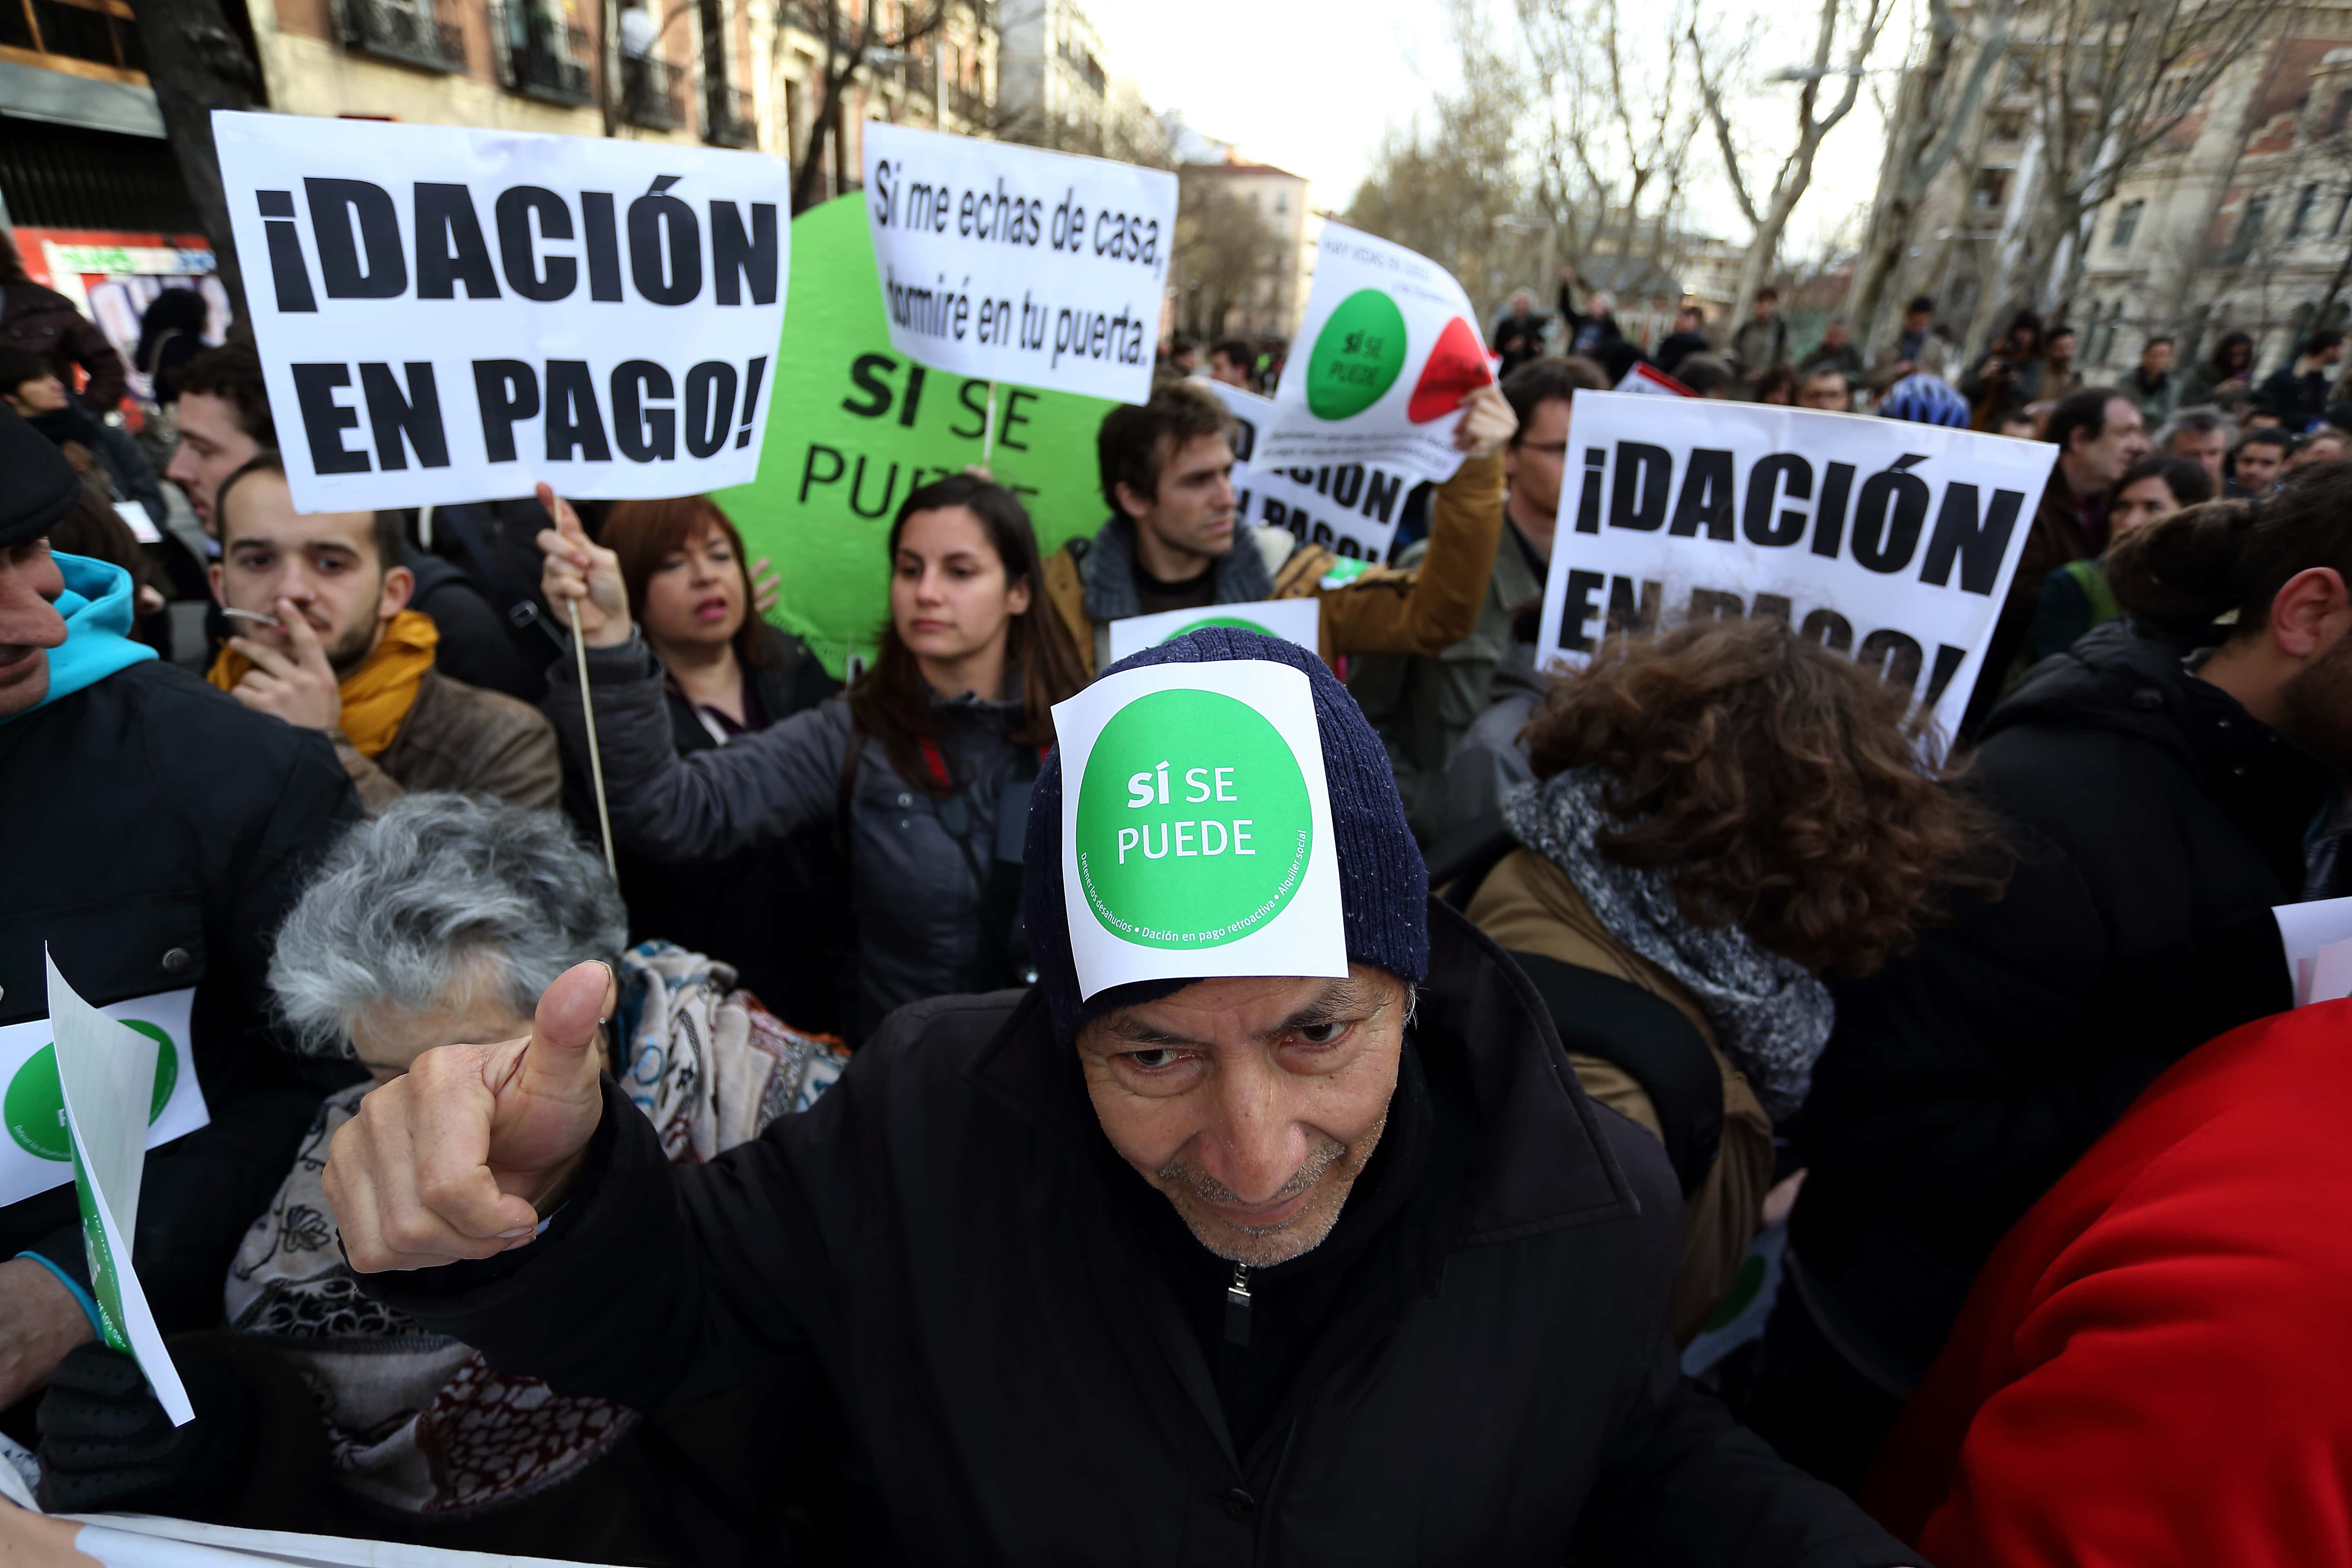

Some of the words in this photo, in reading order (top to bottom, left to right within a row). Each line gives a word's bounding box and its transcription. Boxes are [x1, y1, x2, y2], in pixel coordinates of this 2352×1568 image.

[255, 175, 777, 312] ¡DACIÓN
[906, 182, 949, 234] me
[959, 176, 1043, 246] echas
[1052, 186, 1084, 252] de
[1094, 209, 1164, 281] casa,
[978, 298, 1011, 346] en
[1021, 287, 1047, 350] tu
[1052, 300, 1147, 369] puerta.
[290, 362, 450, 475] EN
[472, 355, 768, 464] PAGO!
[949, 379, 1040, 452] SE
[1575, 441, 2025, 596] ¡DACIÓN
[1558, 568, 1662, 653] EN
[1127, 760, 1170, 808] SÍ
[1185, 767, 1238, 803] SE
[1081, 852, 1092, 888] Detener
[1089, 886, 1098, 902] los
[1096, 900, 1132, 932] desahucios
[1142, 927, 1178, 941] Dación
[1182, 932, 1195, 941] en
[1198, 928, 1225, 942] pago
[1227, 900, 1276, 934] retroactiva
[1278, 859, 1301, 896] Alquiler
[1296, 830, 1306, 860] social
[1118, 820, 1256, 865] PUEDE
